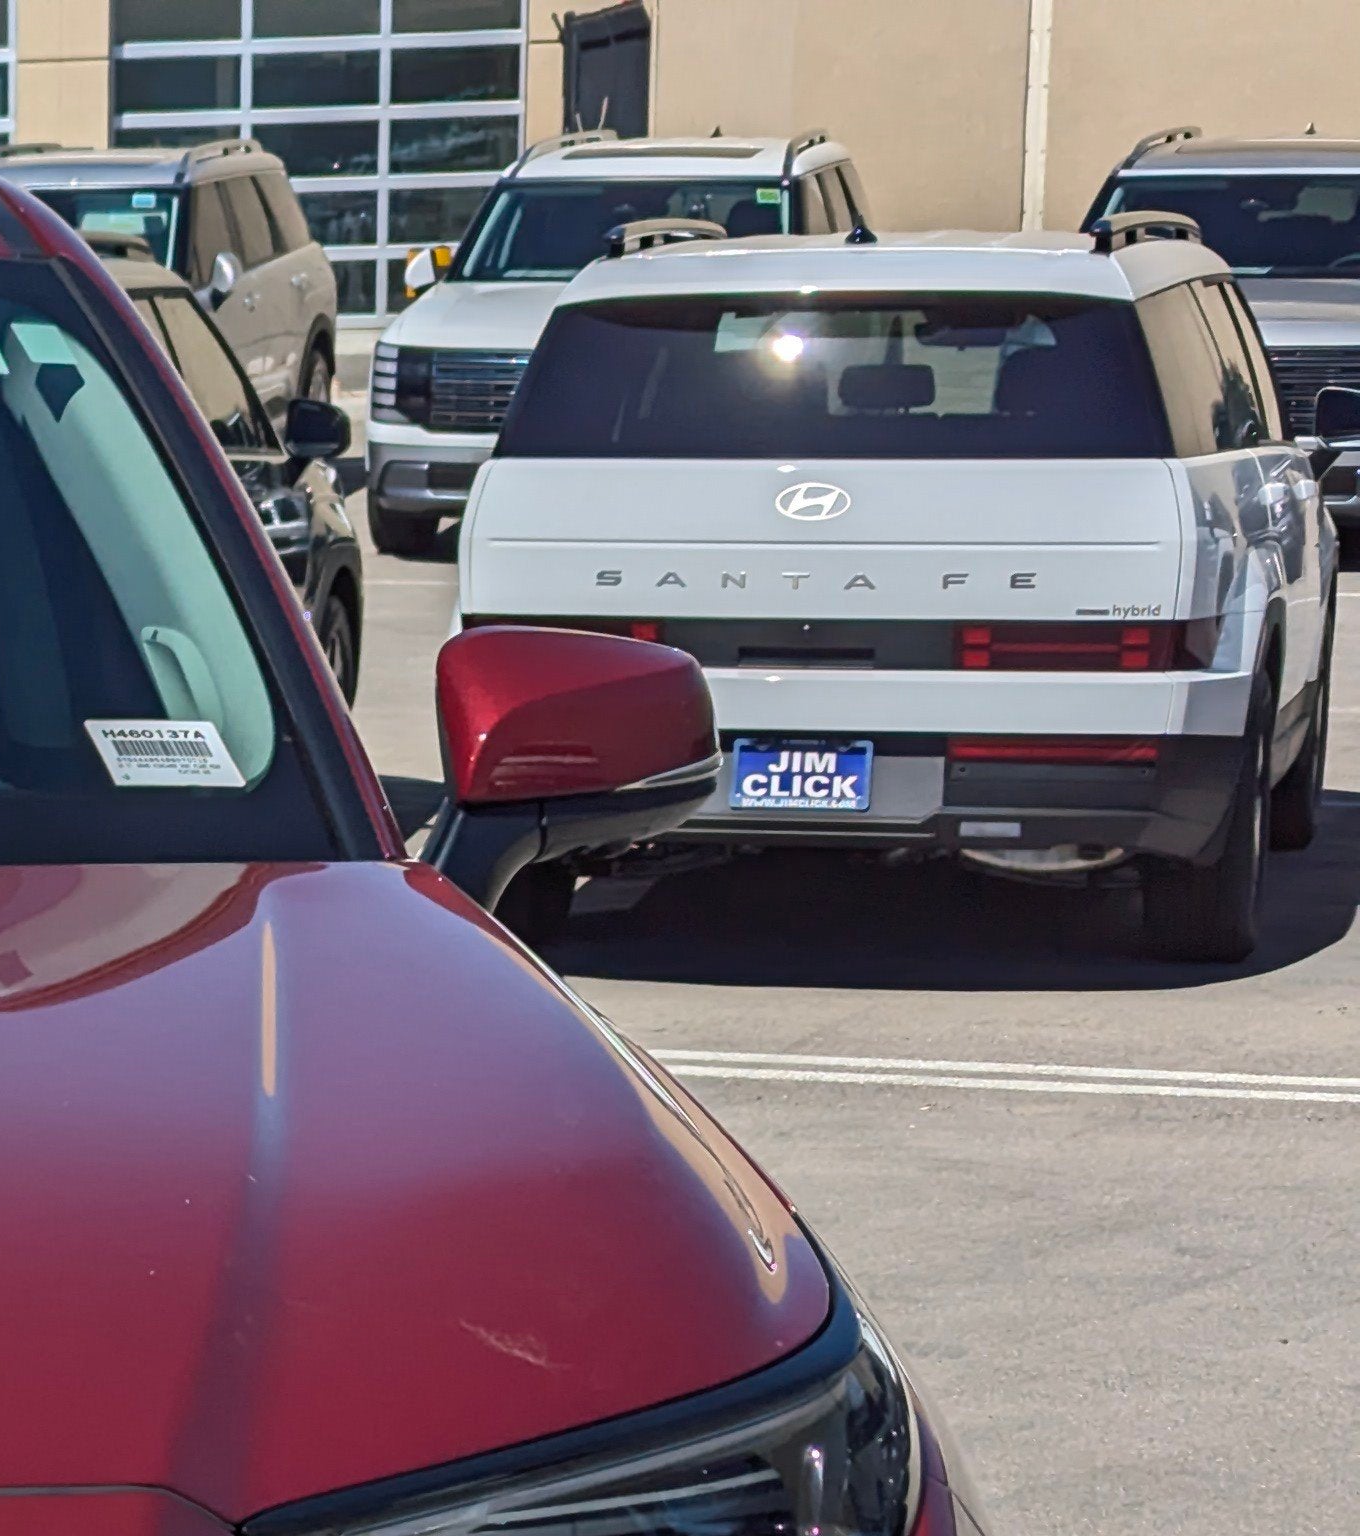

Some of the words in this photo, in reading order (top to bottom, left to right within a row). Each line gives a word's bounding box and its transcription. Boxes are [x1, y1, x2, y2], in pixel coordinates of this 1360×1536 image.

[594, 569, 877, 591] SANTA
[941, 572, 1038, 590] FE
[1112, 604, 1162, 620] hybrid
[101, 729, 206, 740] H460137A
[767, 750, 838, 774] JIM
[741, 773, 859, 798] CLICK
